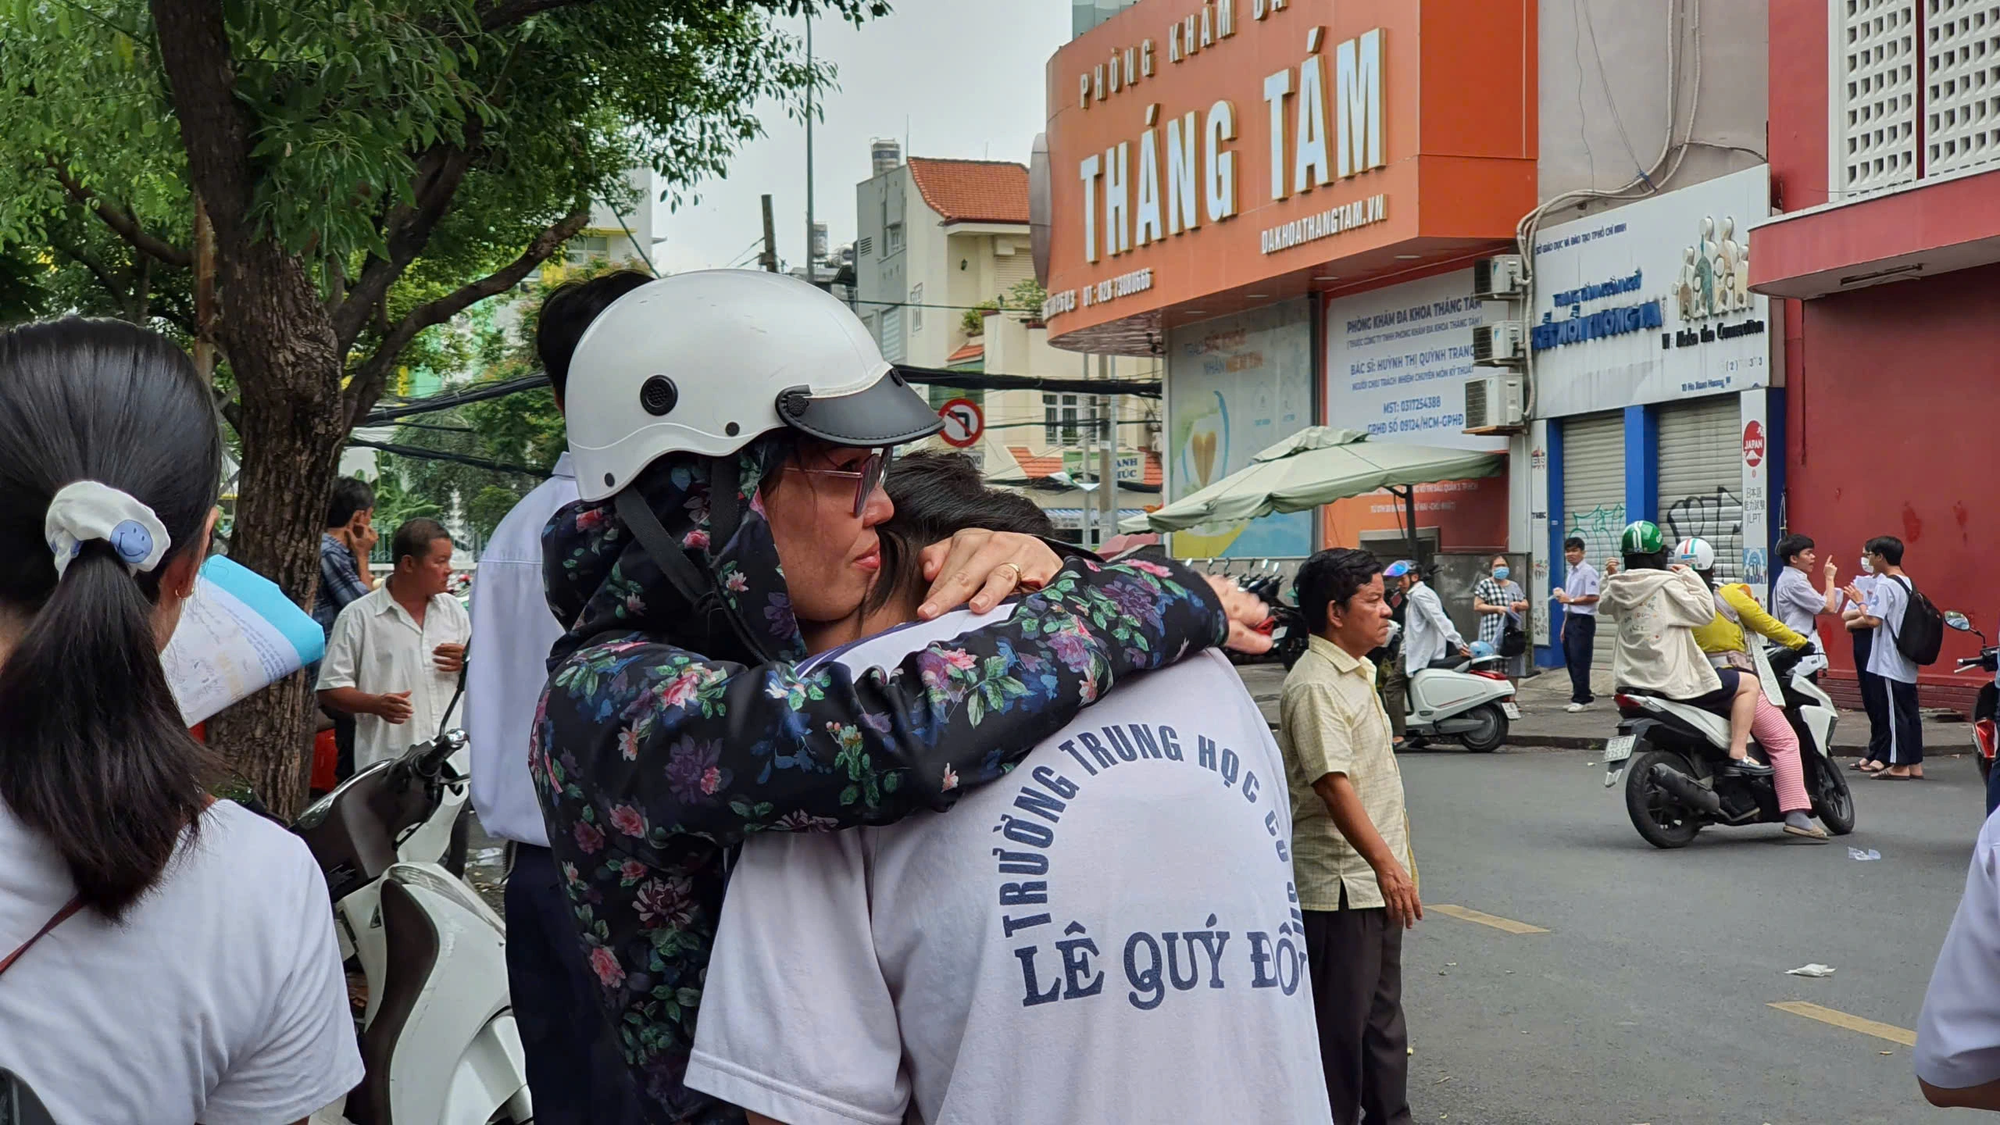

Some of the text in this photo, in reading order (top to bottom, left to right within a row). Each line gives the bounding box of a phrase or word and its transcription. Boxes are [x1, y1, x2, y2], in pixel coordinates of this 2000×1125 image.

[1079, 38, 1154, 109] PHÒNG
[1080, 25, 1387, 264] THÁNG TÁM
[1261, 193, 1388, 255] DAKHOATHANGTAM.VN
[1346, 315, 1373, 334] PHÒNG
[1372, 309, 1396, 330] KHÁM
[1409, 304, 1433, 322] KHOA
[1433, 296, 1462, 317] THÁNG
[1350, 361, 1365, 376] BÁC
[1383, 400, 1400, 414] MST:
[1744, 438, 1763, 450] JAPAN
[992, 765, 1080, 938] TRƯỜNG
[1058, 723, 1184, 777] TRUNG
[1197, 734, 1260, 804] HỌC
[1014, 921, 1105, 1008] LÊ
[1123, 913, 1230, 1010] QUÝ
